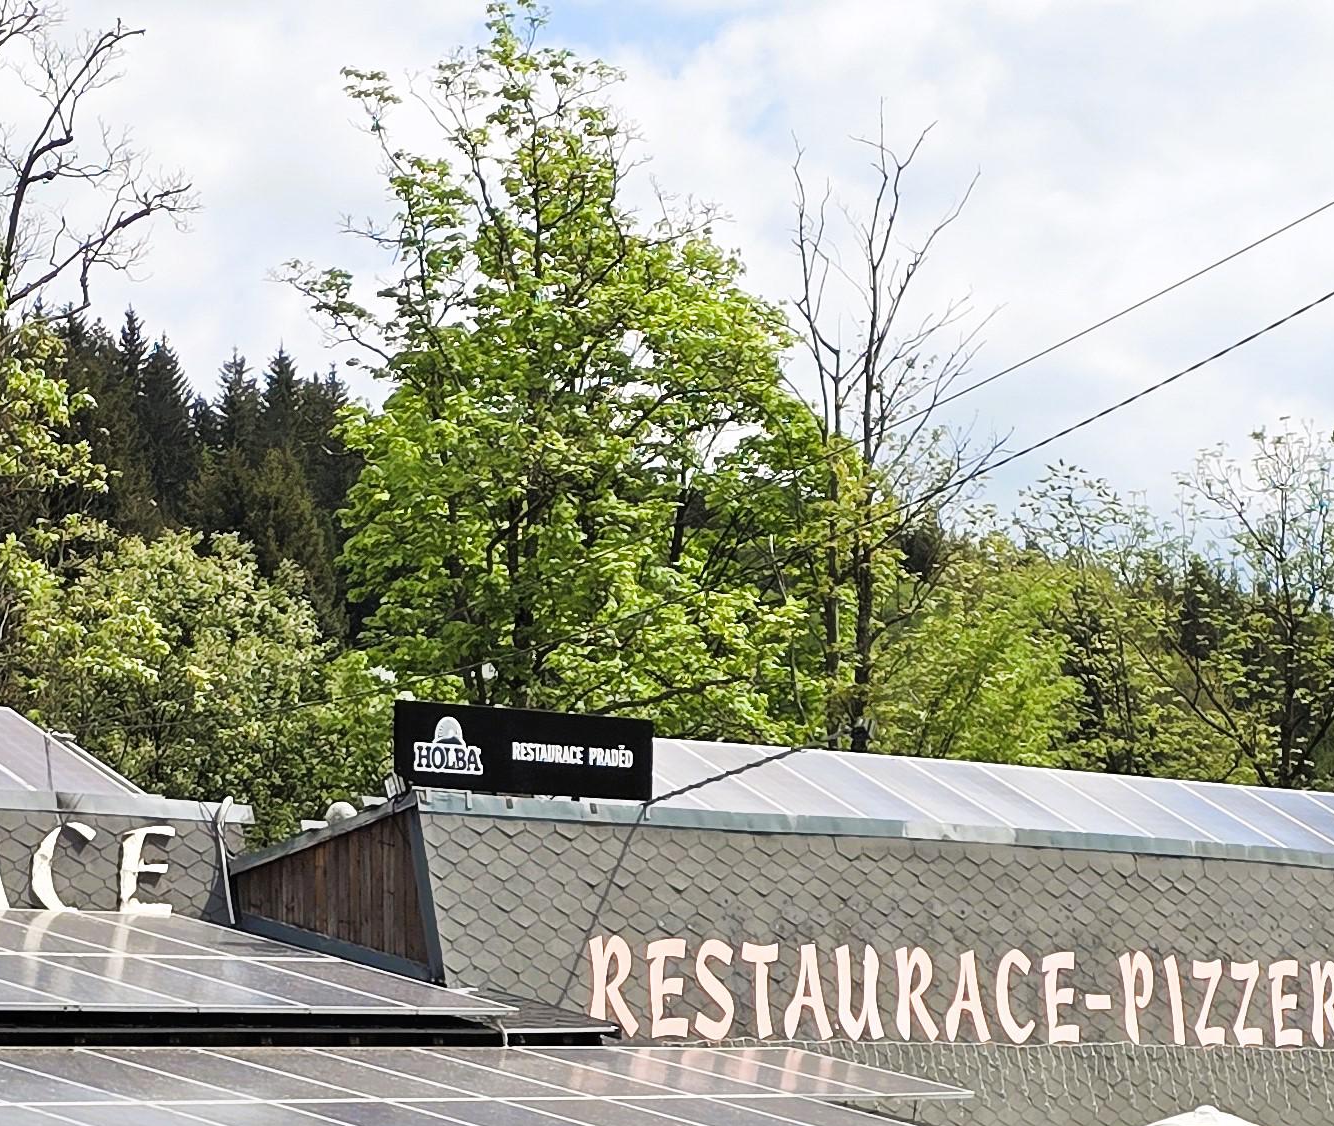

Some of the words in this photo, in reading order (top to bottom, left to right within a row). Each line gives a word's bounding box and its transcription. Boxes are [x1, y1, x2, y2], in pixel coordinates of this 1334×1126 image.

[415, 743, 482, 774] HOLBA
[512, 742, 584, 765] RESTAURACE
[589, 745, 634, 768] PRADĚD
